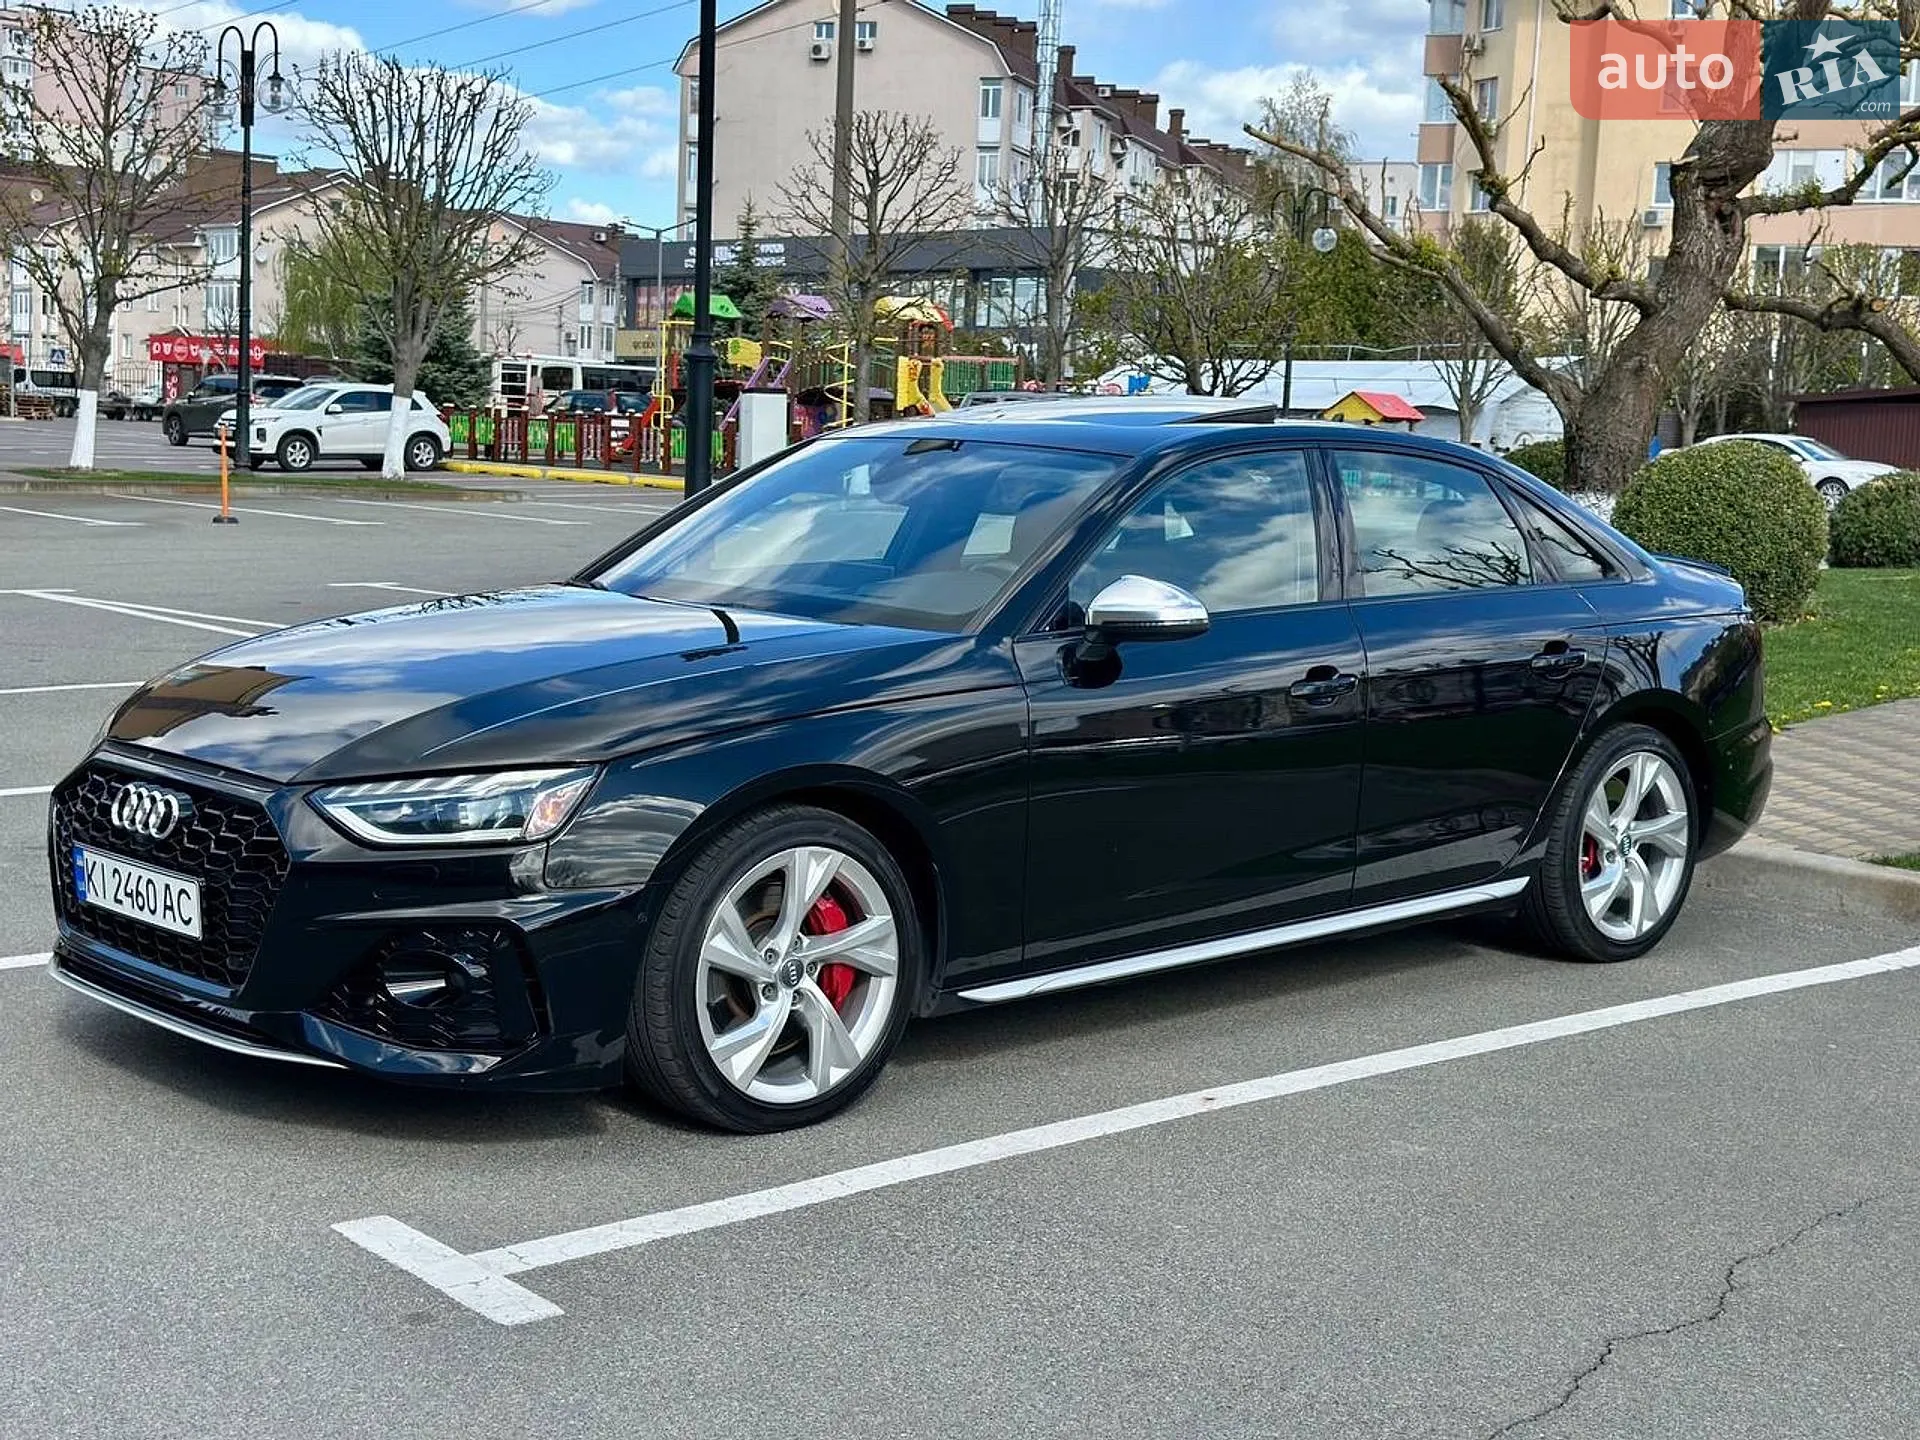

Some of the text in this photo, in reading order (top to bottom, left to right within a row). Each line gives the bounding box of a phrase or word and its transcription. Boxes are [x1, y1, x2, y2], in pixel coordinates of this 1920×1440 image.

[85, 857, 193, 926] KI 2460 AC
